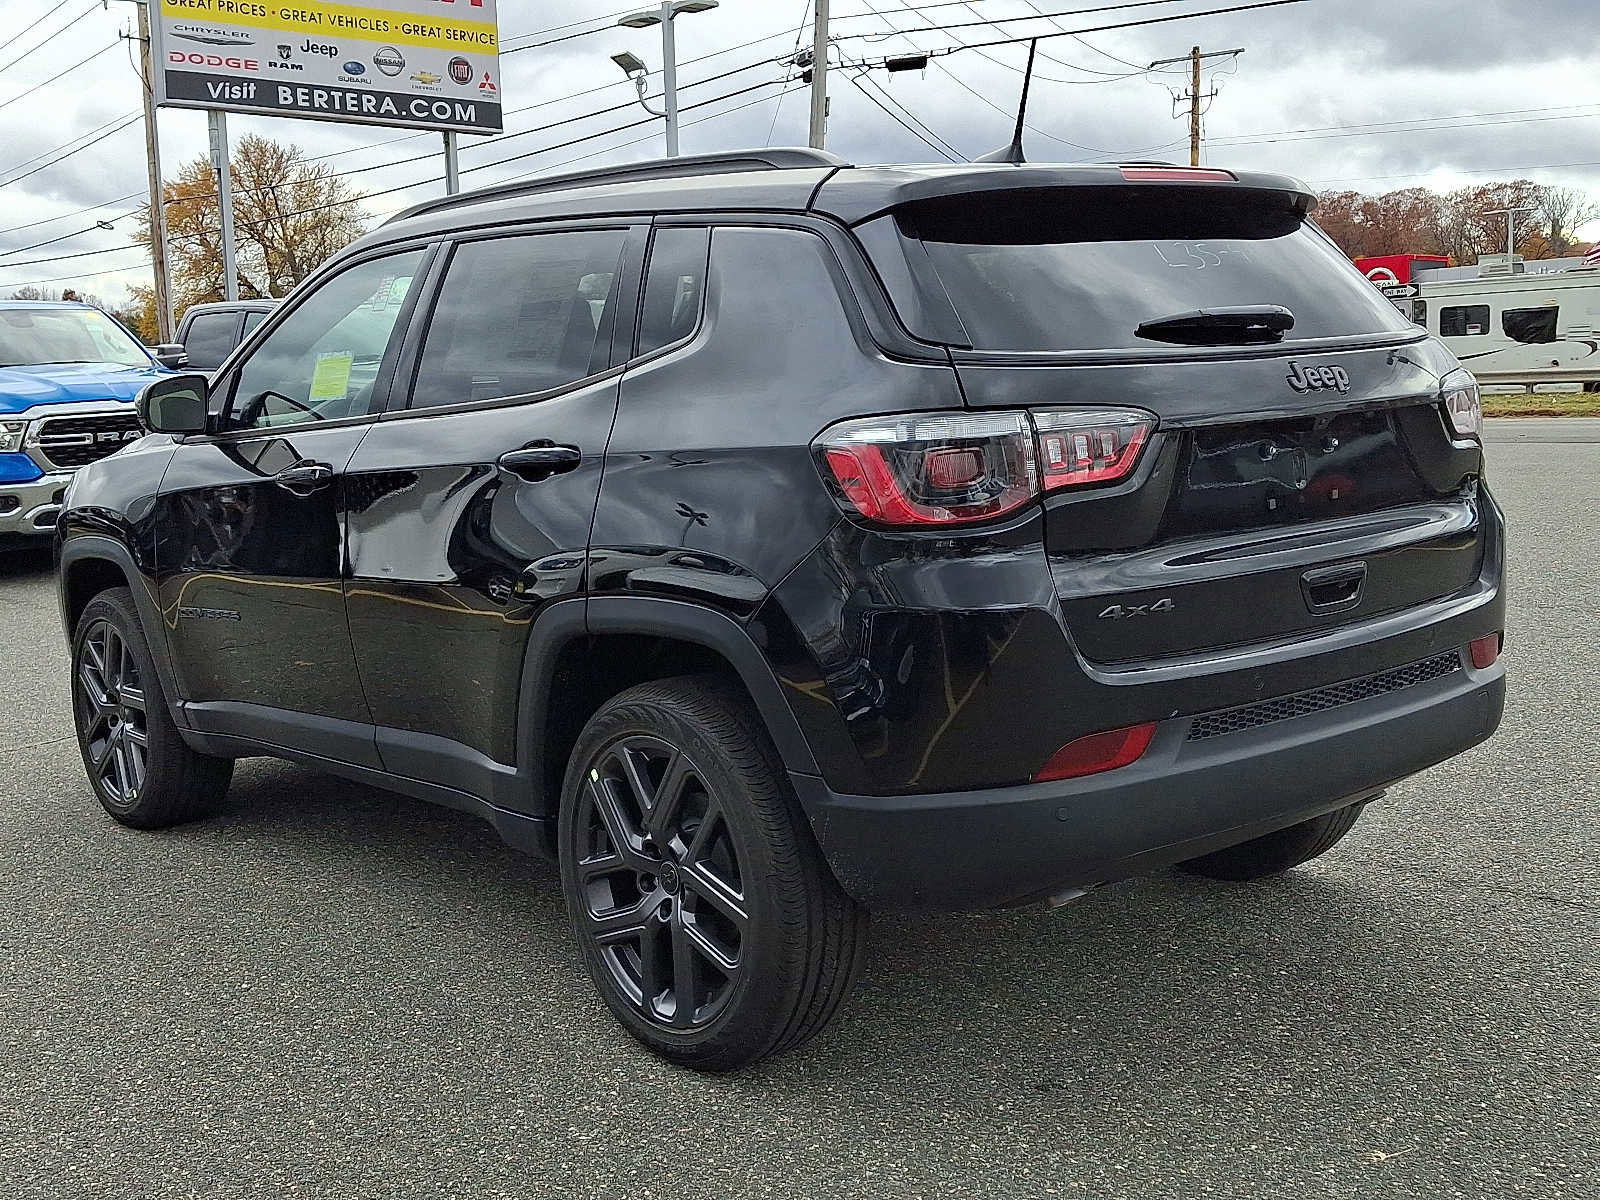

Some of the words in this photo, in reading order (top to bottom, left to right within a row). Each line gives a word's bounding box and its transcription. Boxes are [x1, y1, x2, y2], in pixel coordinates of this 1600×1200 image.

[166, 0, 211, 10] GREAT
[218, 0, 266, 17] PRICES
[280, 8, 323, 25] GREAT
[328, 13, 389, 32] VEHICLES
[402, 23, 442, 39] GREAT
[446, 28, 495, 45] SERVICE
[174, 24, 250, 39] CHRYSLER
[300, 39, 339, 58] Jeep
[169, 51, 260, 71] DODGE
[268, 61, 304, 71] RAM
[375, 56, 403, 66] NISSAN
[338, 75, 372, 85] SUBARU
[453, 64, 468, 79] FIAT
[207, 81, 257, 99] Visit
[277, 86, 477, 123] BERTERA.COM
[1286, 361, 1350, 395] Jeep
[96, 430, 148, 442] RA
[1098, 598, 1175, 619] 4x4
